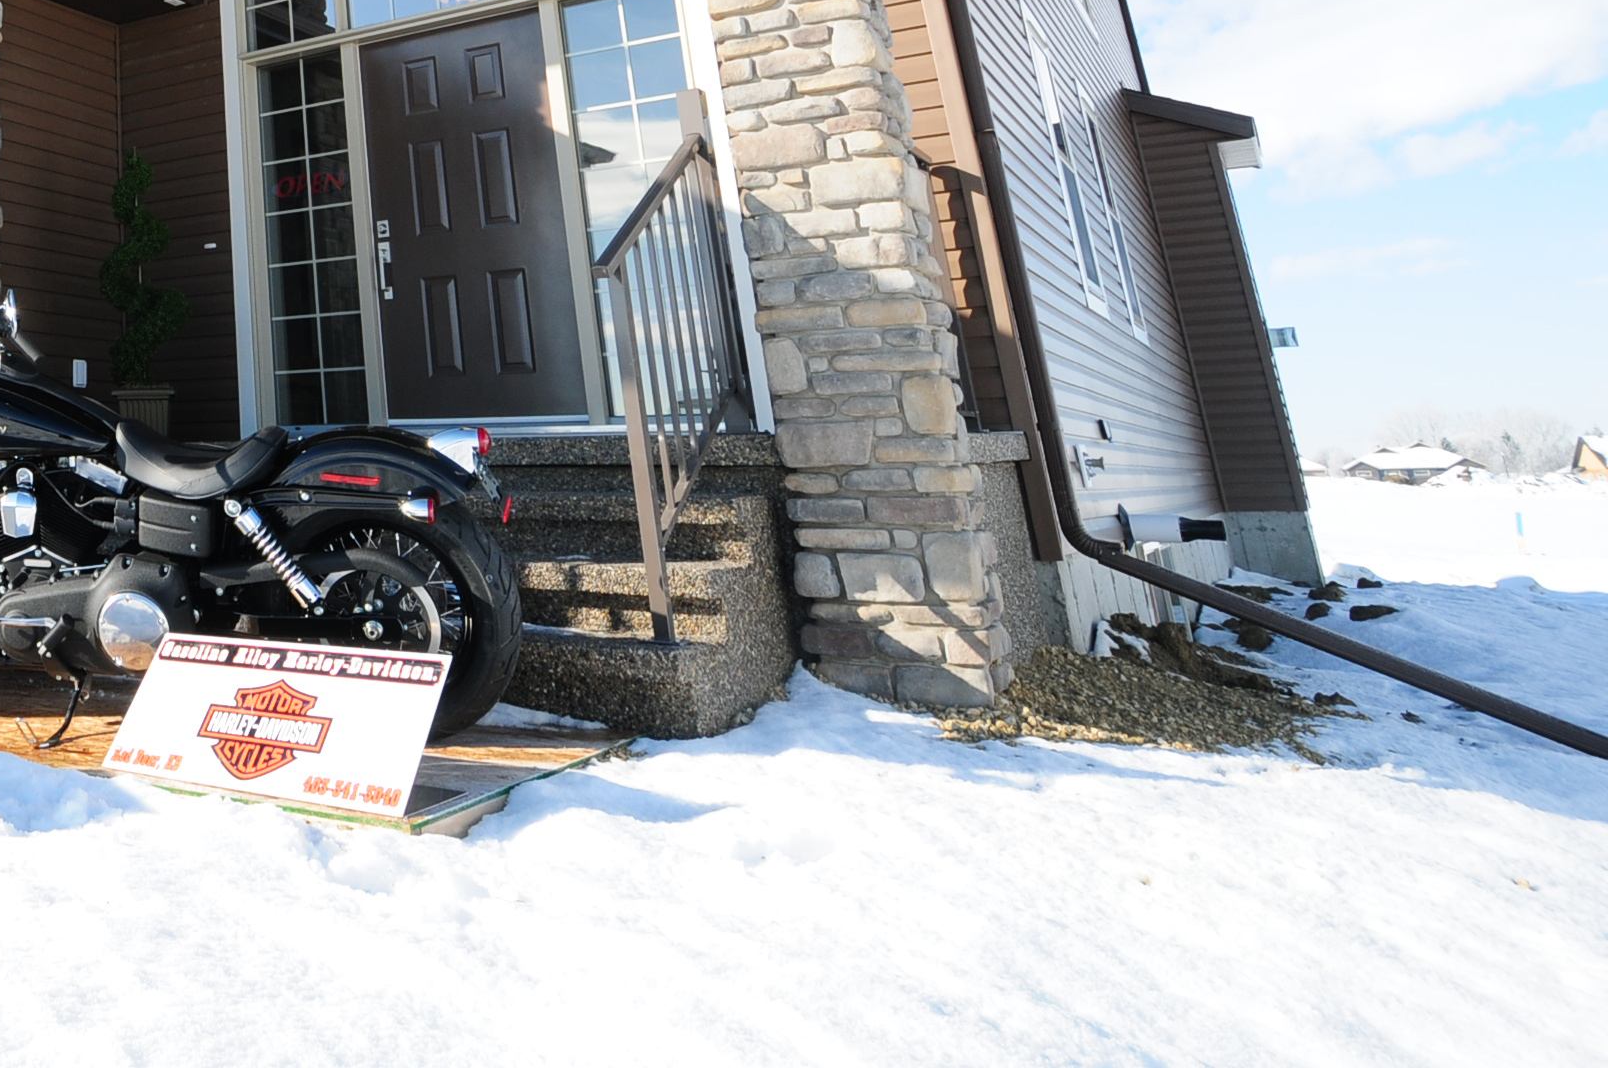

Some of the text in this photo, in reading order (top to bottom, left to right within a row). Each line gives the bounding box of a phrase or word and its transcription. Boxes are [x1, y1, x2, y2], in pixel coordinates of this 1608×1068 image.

[276, 171, 345, 198] OPEN
[160, 640, 230, 663] Gasoline
[232, 646, 281, 670] Alley
[242, 691, 304, 717] MOTOR
[206, 709, 324, 746] HARLEY-DAVIDSON
[222, 740, 286, 774] CYCLES
